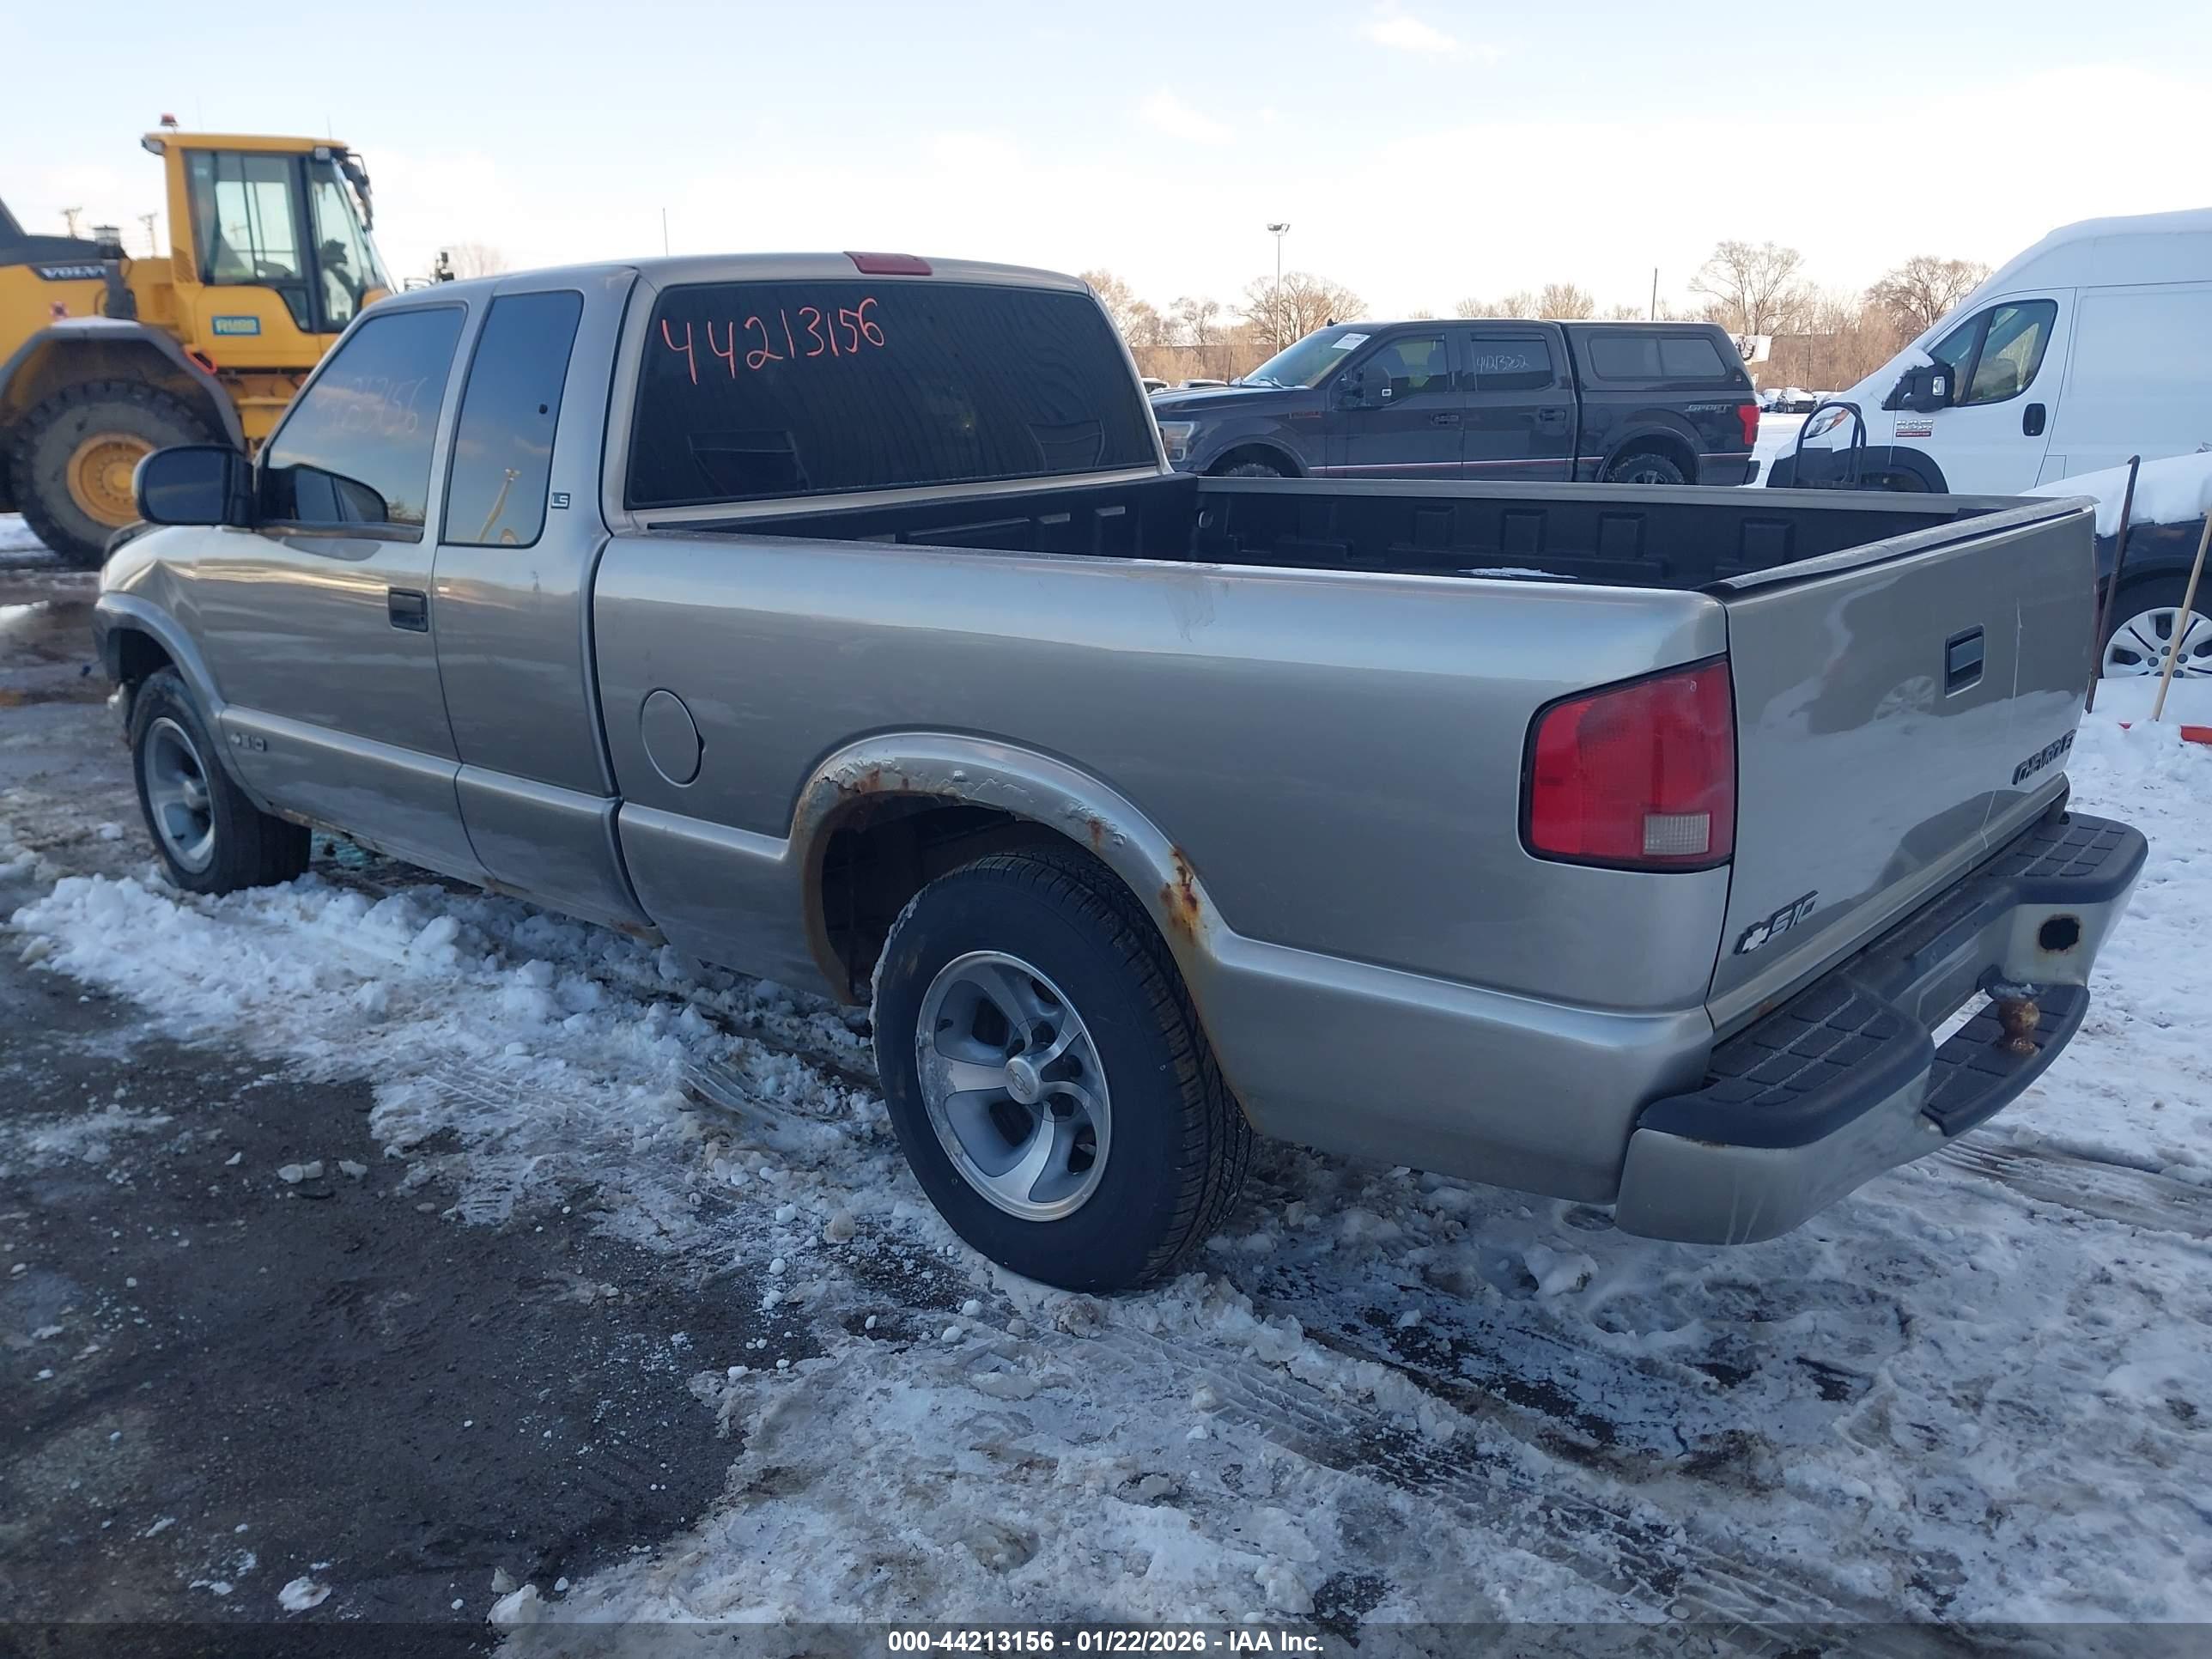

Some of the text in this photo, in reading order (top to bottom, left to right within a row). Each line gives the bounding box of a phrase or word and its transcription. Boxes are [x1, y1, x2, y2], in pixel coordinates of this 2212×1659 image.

[40, 265, 106, 278] VOLV
[661, 297, 884, 385] 44213156
[551, 494, 568, 507] LS
